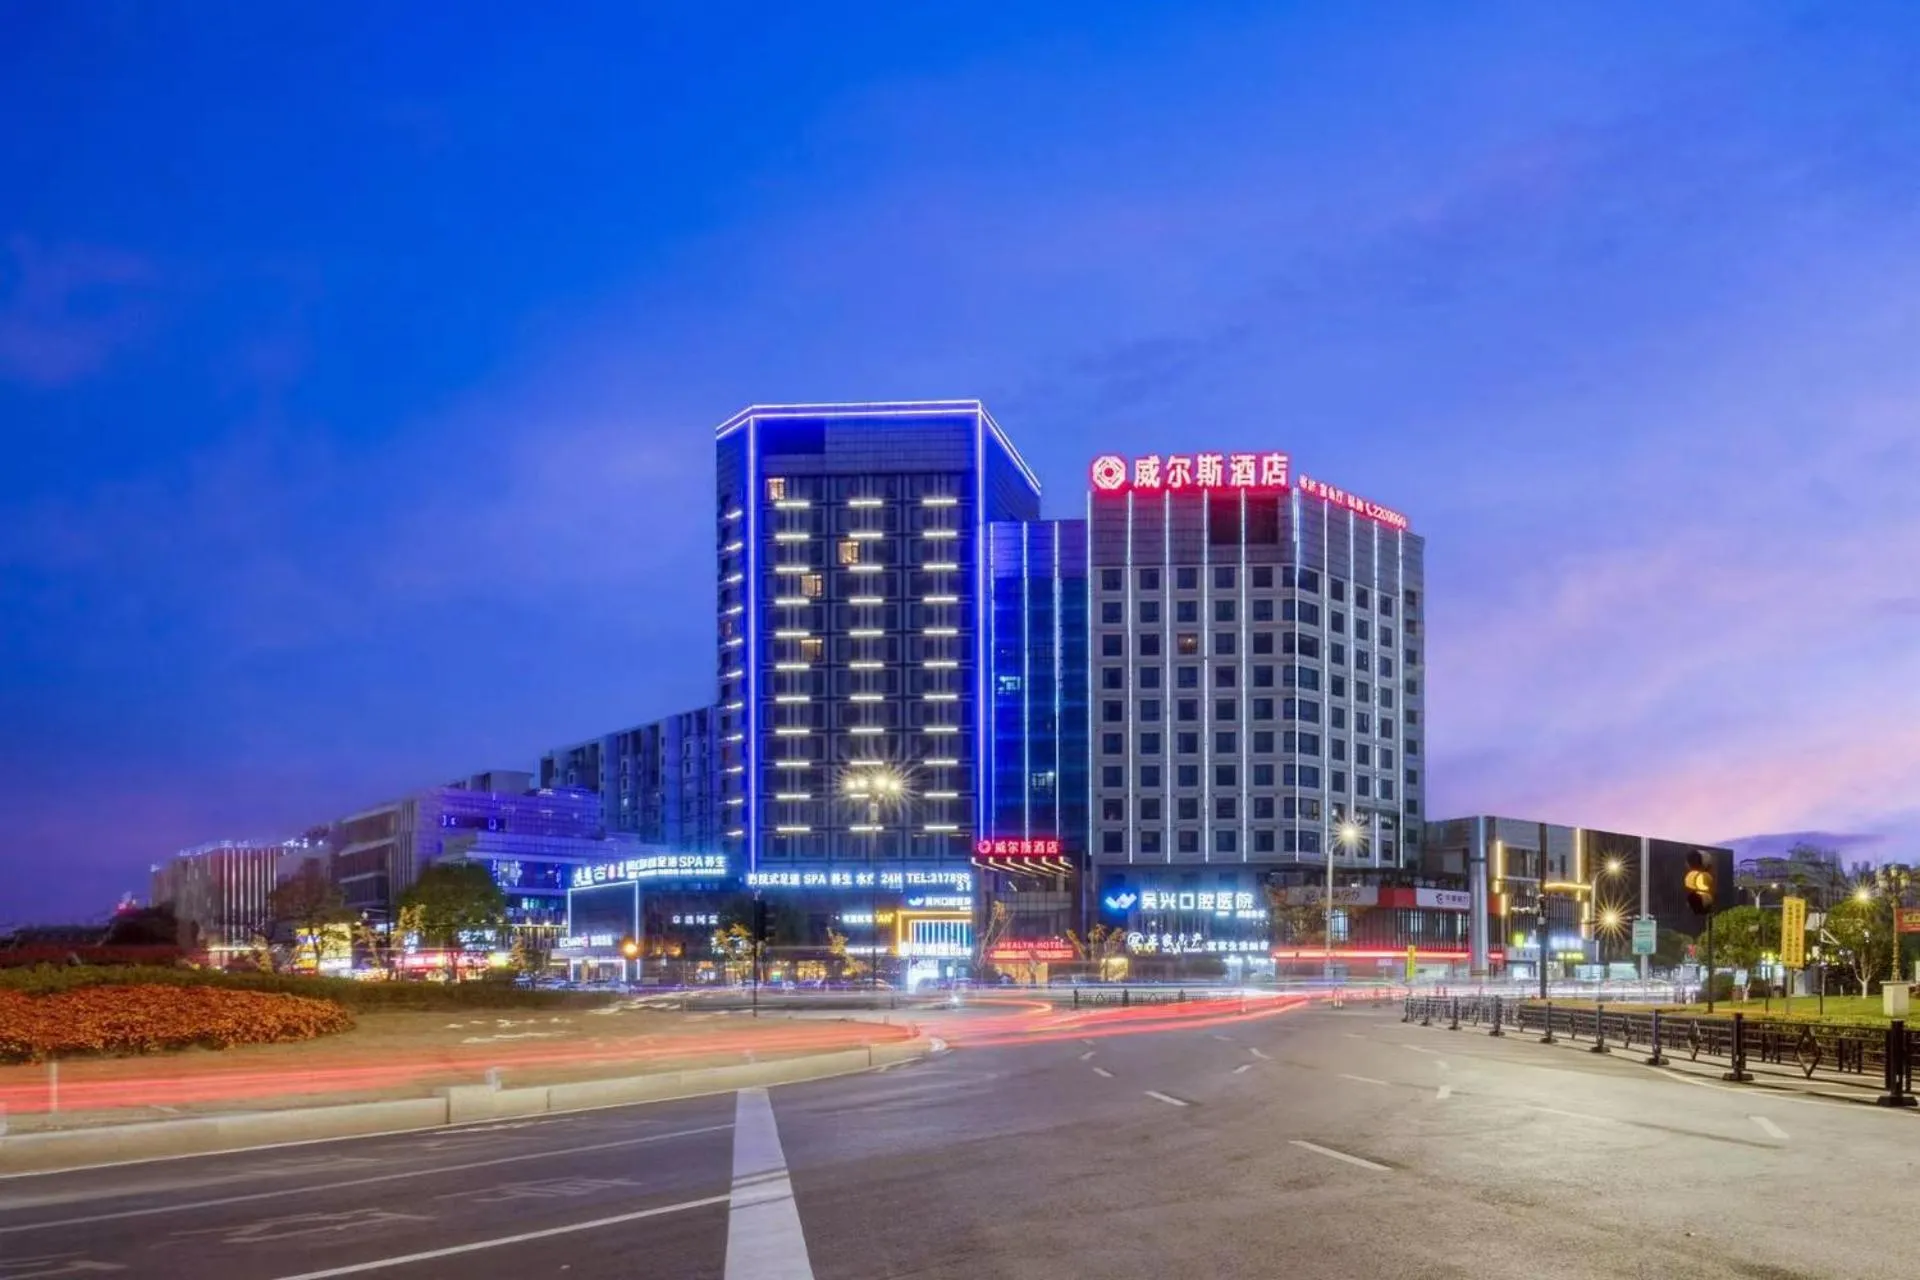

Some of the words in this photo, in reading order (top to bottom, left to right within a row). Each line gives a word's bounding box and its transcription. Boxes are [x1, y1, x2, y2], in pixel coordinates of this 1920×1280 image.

[1134, 453, 1289, 488] 威尔斯酒店
[994, 840, 1058, 854] 威尔斯酒店
[803, 873, 825, 884] SPA
[1142, 891, 1254, 911] 吴兴口腔医院
